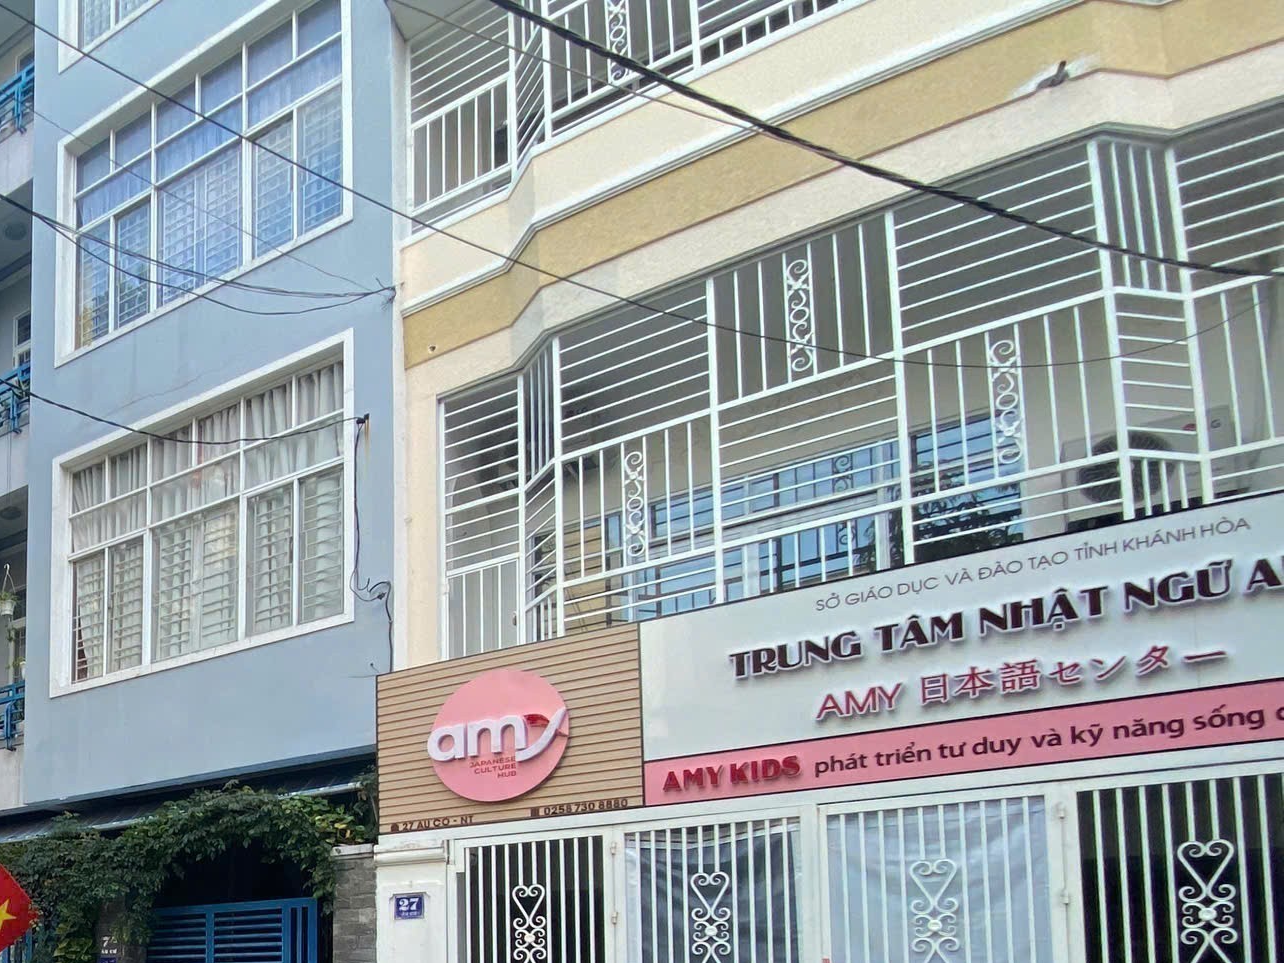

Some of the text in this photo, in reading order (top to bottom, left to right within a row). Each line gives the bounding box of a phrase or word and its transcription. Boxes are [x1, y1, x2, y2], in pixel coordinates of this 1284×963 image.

[815, 516, 1250, 611] SỞ GIÁO DỤC VÀ ĐÀO TẠO TỈNH KHÁNH HÒA
[729, 555, 1284, 679] TRUNG TÂM NHẬT NGỮ A
[816, 645, 1227, 720] AMY 日本語センター
[662, 765, 723, 793] AMY
[730, 755, 801, 785] KIDS
[815, 752, 868, 778] phát
[875, 742, 932, 767] triển
[938, 741, 967, 758] tư
[972, 736, 1021, 756] duy
[1030, 728, 1062, 748] và
[1070, 723, 1104, 747] kỹ
[1113, 718, 1184, 739] năng
[1193, 704, 1265, 731] sống
[469, 756, 516, 768] JAPANESE
[474, 763, 516, 775] CULTURE
[497, 770, 516, 779] HUB
[544, 805, 572, 817] 0258
[573, 802, 595, 813] 730
[402, 821, 414, 832] 27
[460, 815, 474, 825] NT
[399, 897, 419, 910] 27
